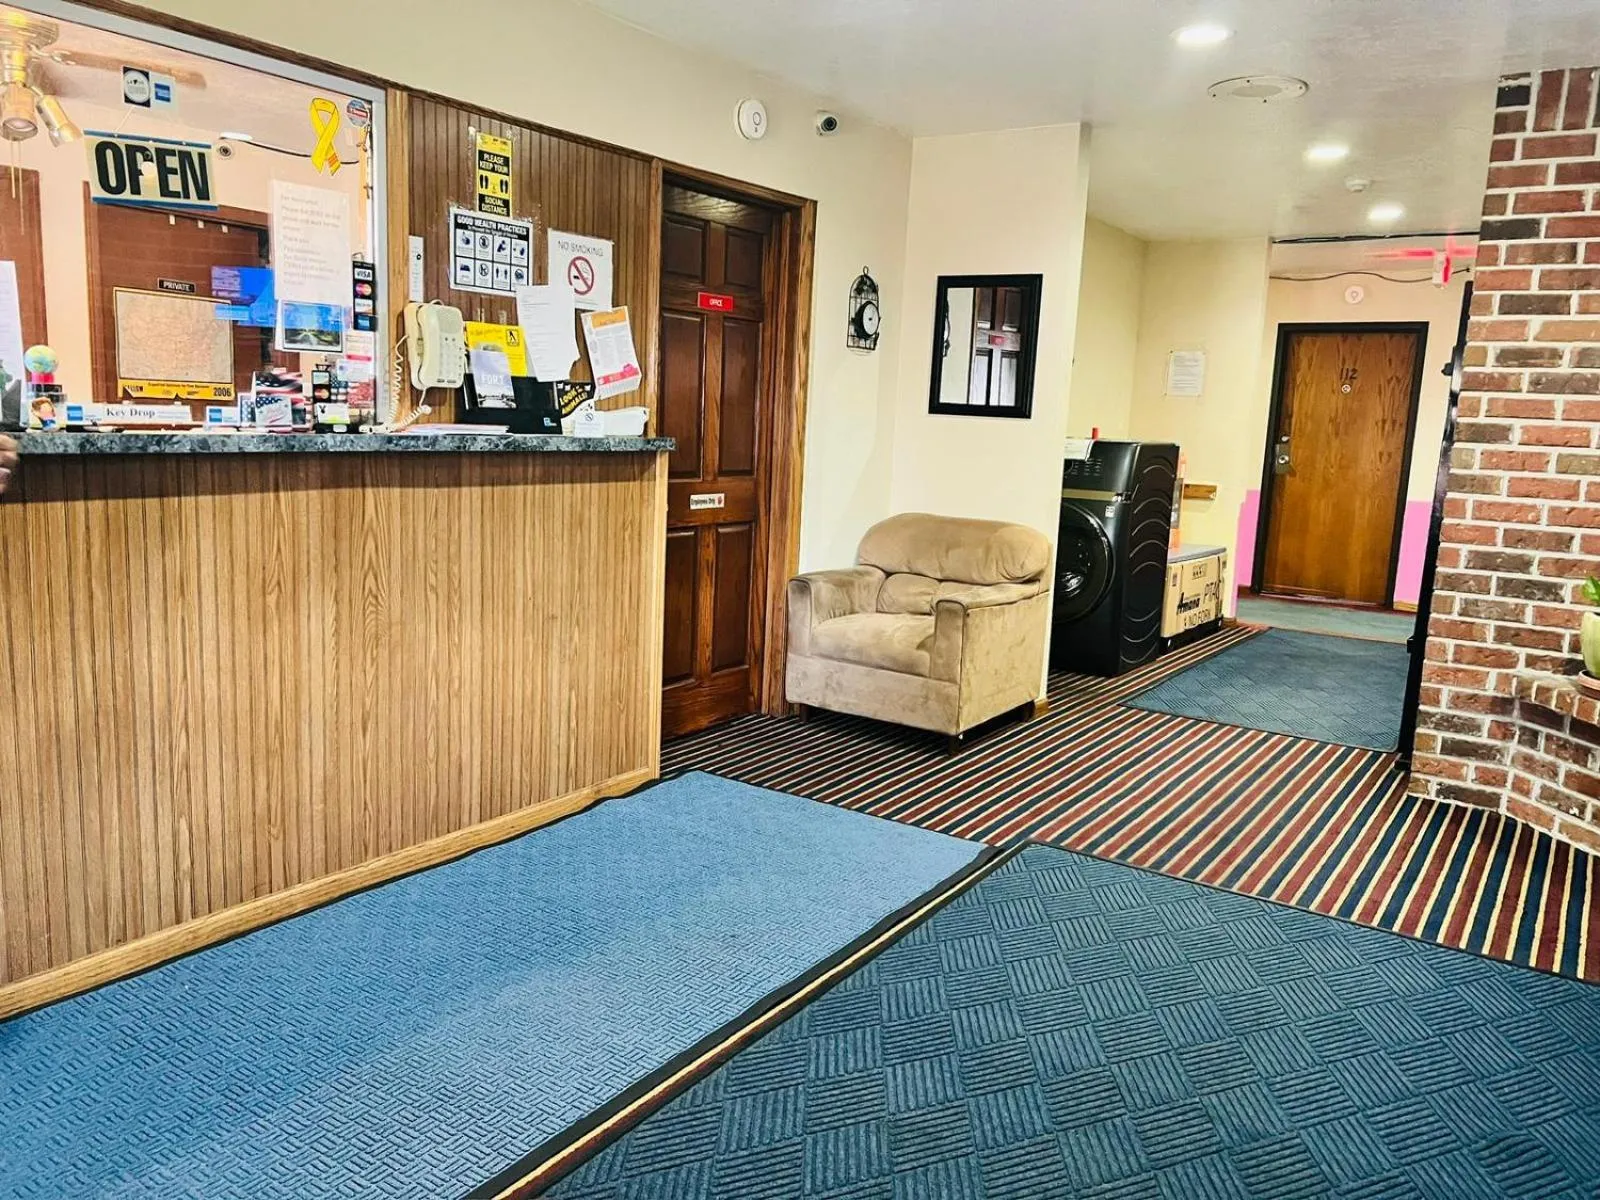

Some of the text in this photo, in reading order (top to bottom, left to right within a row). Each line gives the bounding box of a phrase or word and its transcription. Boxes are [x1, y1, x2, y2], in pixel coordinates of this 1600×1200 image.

[484, 153, 504, 165] PLEASE
[95, 140, 210, 201] OPEN
[480, 160, 508, 174] KEEP YOUR
[484, 196, 504, 206] SOCIAL
[482, 203, 507, 215] DISTANCE
[457, 215, 527, 235] GOOD HEALTH PRACTICES
[558, 240, 604, 257] NO SMOKING
[356, 270, 371, 279] VISA
[163, 281, 191, 291] PRIVATE
[709, 298, 723, 307] OFFICE
[1340, 367, 1358, 381] 112
[213, 387, 232, 397] 2006
[559, 388, 577, 406] LOOK
[106, 408, 126, 418] Key
[130, 408, 155, 419] Drop
[1177, 592, 1200, 615] Amana
